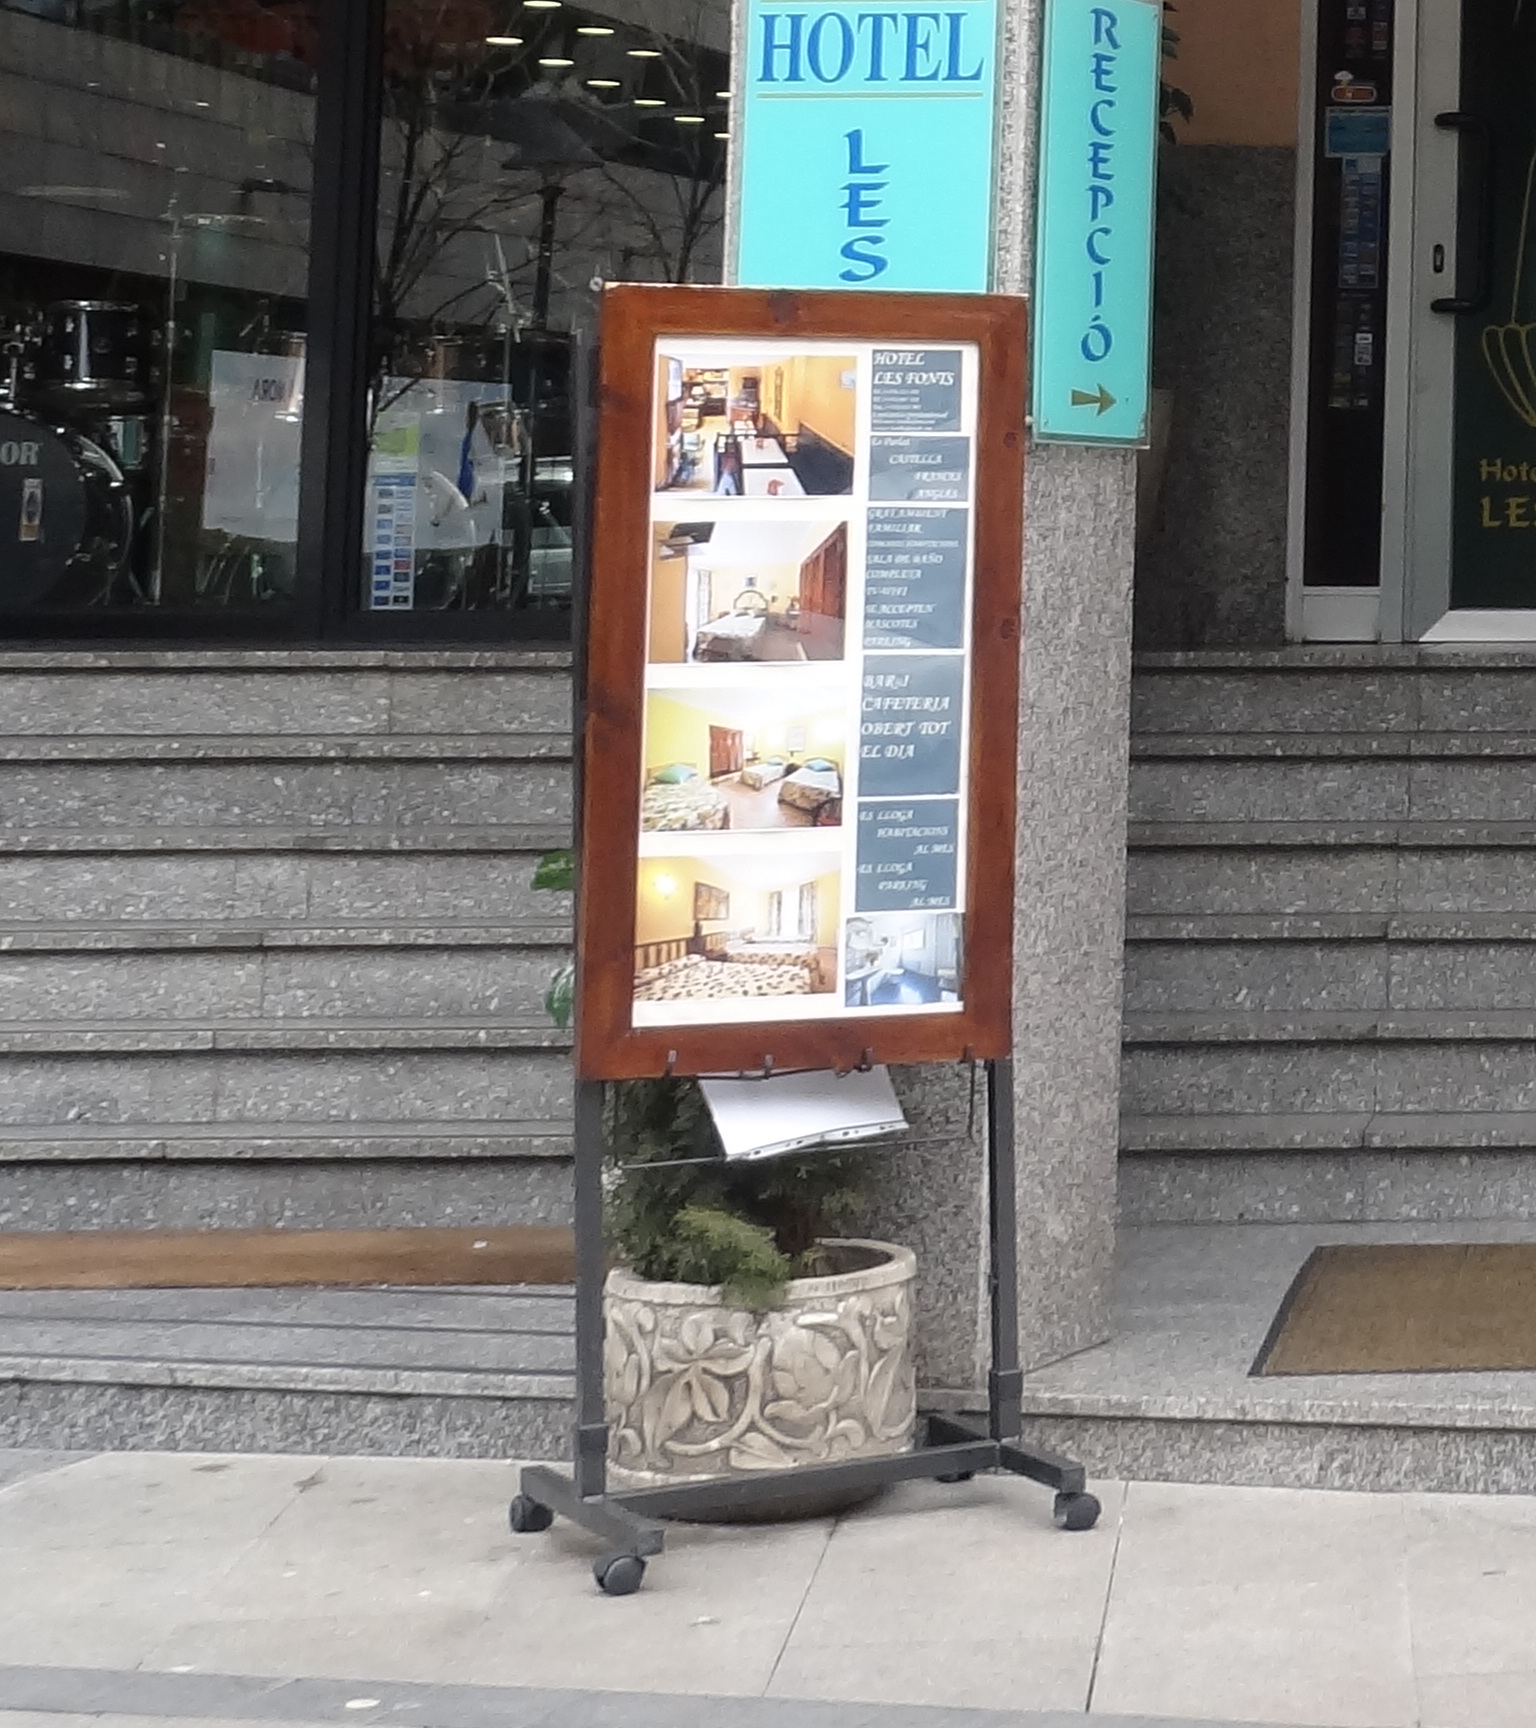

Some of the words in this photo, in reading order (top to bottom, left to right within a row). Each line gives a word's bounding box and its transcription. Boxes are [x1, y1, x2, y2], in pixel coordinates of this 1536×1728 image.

[756, 11, 985, 84] HOTEL
[1080, 7, 1122, 363] RECEPCIÓ
[838, 128, 892, 282] LES
[873, 352, 925, 365] HOTEL
[873, 372, 903, 385] LES
[904, 372, 955, 386] FONTS
[862, 696, 950, 712] CAFETERIA
[861, 721, 916, 738] OBERT
[918, 721, 952, 736] TOT
[860, 744, 882, 759] EL
[883, 744, 915, 760] DIA
